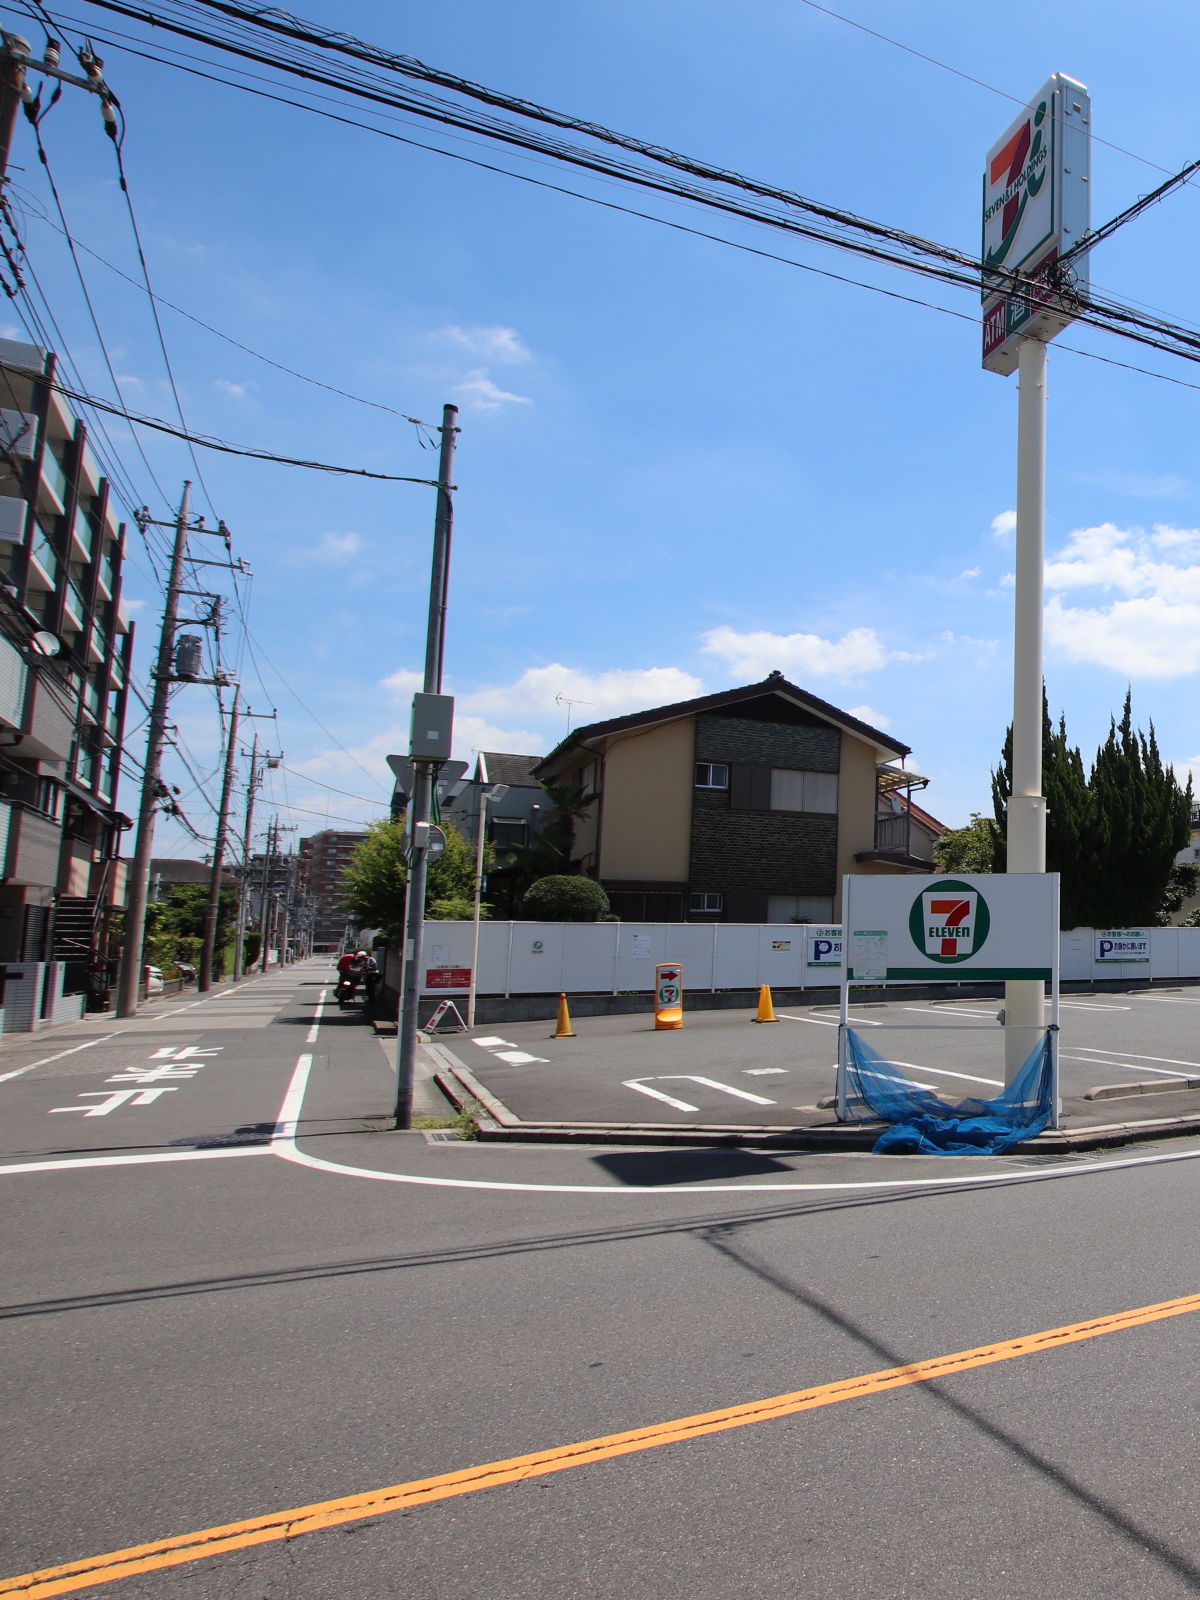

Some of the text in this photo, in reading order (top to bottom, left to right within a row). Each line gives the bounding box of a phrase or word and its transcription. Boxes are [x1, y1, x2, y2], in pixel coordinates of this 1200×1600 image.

[1014, 145, 1047, 192] HOLDINGS
[984, 306, 1005, 350] ATM
[814, 940, 832, 960] P
[931, 900, 970, 956] 7
[1100, 940, 1113, 957] P
[47, 1046, 225, 1117] 止まれ
